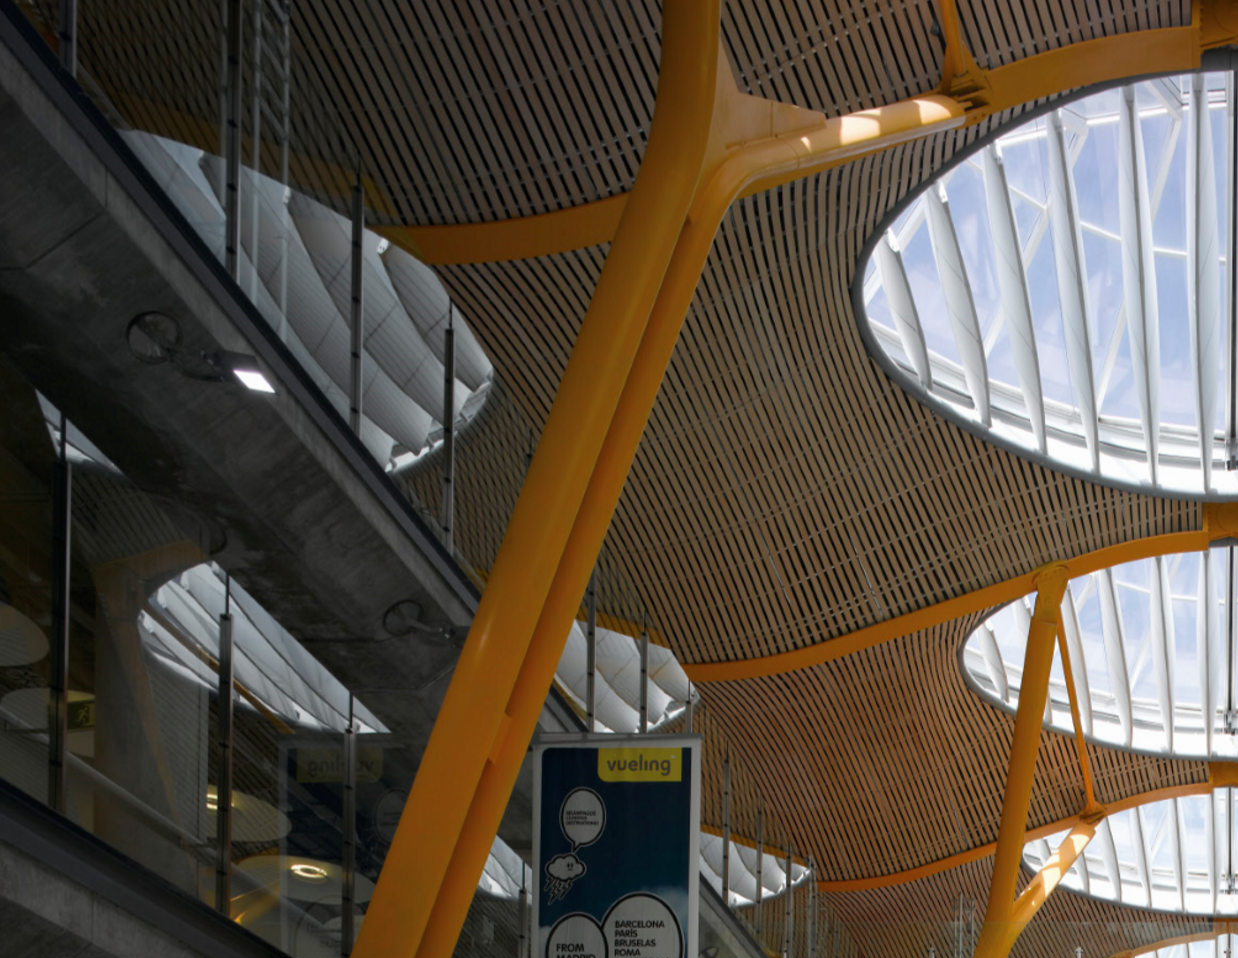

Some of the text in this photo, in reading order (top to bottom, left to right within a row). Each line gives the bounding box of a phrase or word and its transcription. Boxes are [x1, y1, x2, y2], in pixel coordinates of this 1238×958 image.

[606, 754, 671, 775] vueling
[614, 920, 665, 929] BARCELONA
[614, 928, 638, 938] PARÍS
[556, 943, 585, 953] FROM
[614, 939, 656, 948] BRUSELAS
[614, 948, 641, 957] ROMA
